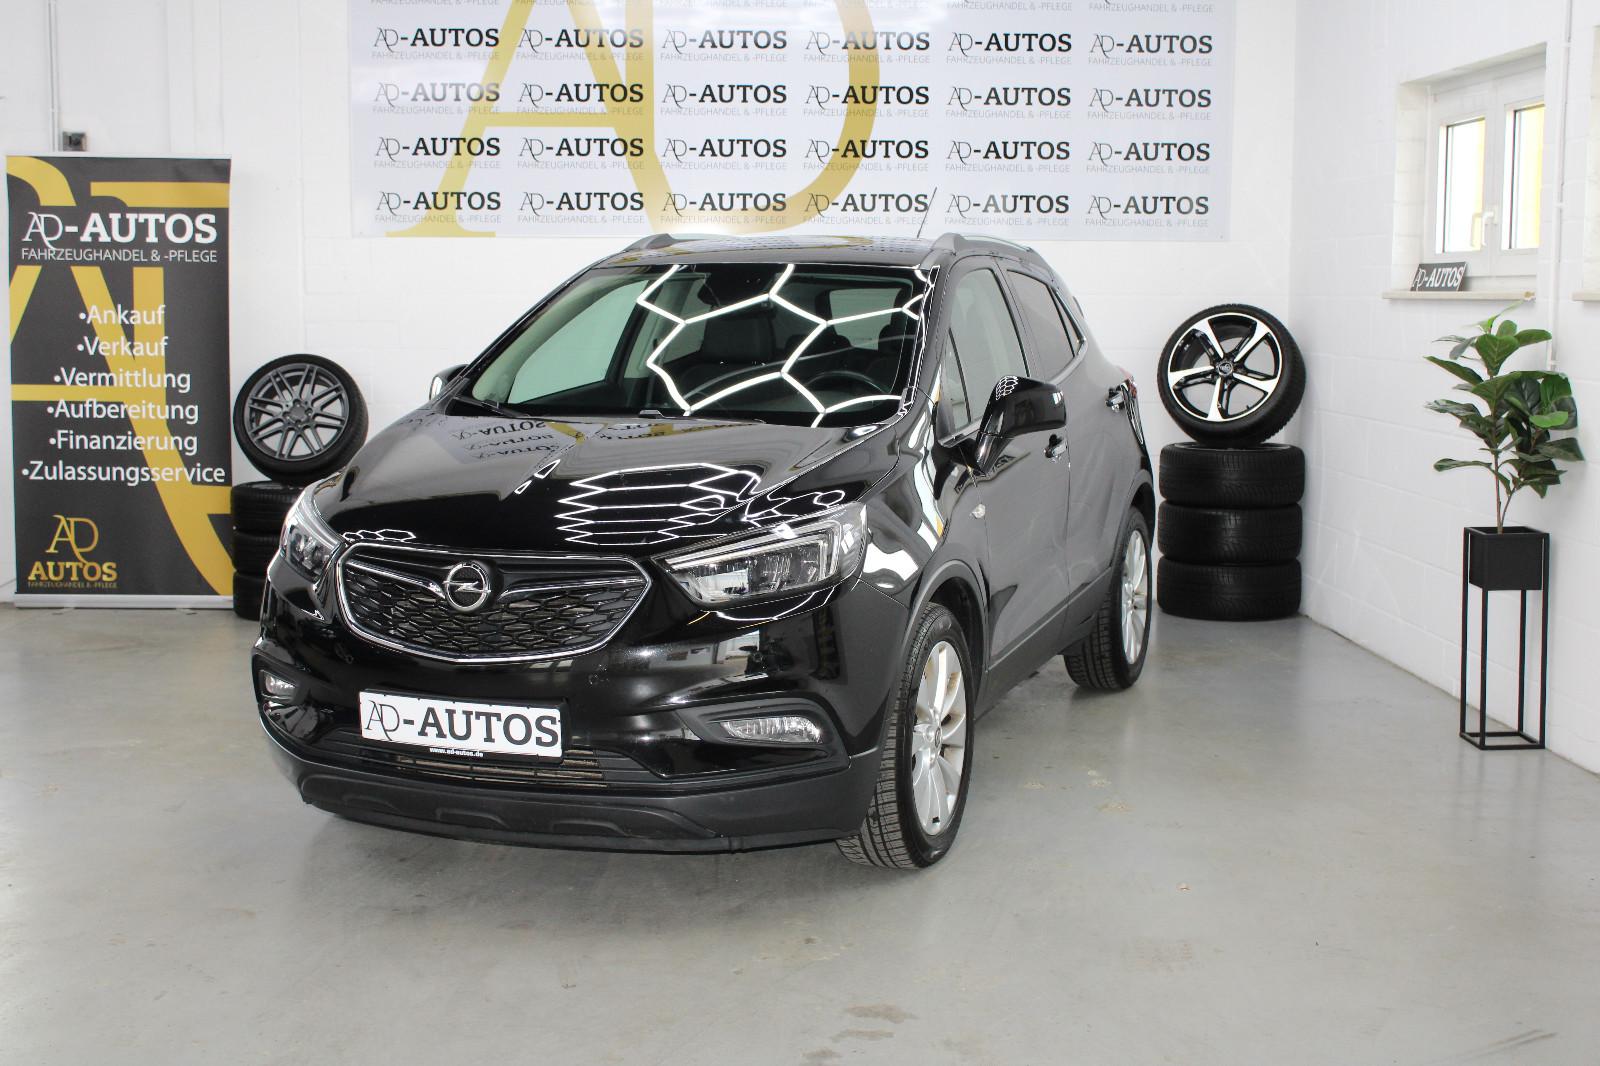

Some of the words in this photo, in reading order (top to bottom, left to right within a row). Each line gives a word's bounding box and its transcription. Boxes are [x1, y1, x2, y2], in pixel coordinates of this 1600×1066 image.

[373, 27, 499, 53] AD-AUTOS
[517, 28, 644, 53] AD-AUTOS
[661, 29, 787, 54] AD-AUTOS
[805, 31, 930, 56] AD-AUTOS
[948, 32, 1072, 56] AD-AUTOS
[1090, 33, 1213, 59] AD-AUTOS
[374, 83, 500, 108] AD-AUTOS
[518, 83, 644, 109] AD-AUTOS
[662, 84, 787, 109] AD-AUTOS
[805, 85, 929, 110] AD-AUTOS
[948, 86, 1071, 110] AD-AUTOS
[1089, 88, 1211, 112] AD-AUTOS
[375, 137, 500, 161] AD-AUTOS
[519, 138, 644, 162] AD-AUTOS
[662, 139, 787, 162] AD-AUTOS
[805, 139, 929, 164] AD-AUTOS
[947, 141, 1070, 165] AD-AUTOS
[1088, 142, 1210, 165] AD-AUTOS
[376, 192, 501, 216] AD-AUTOS
[520, 192, 644, 216] AD-AUTOS
[663, 193, 787, 217] AD-AUTOS
[805, 193, 928, 217] AD-AUTOS
[946, 194, 1069, 218] AD-AUTOS
[1087, 196, 1209, 220] AD-AUTOS
[22, 212, 217, 249] AD-AUTOS
[21, 248, 147, 261] FAHRZEUGHANDEL
[151, 250, 160, 261] &
[164, 250, 217, 263] -PFLEGE
[86, 304, 166, 325] Ankauf
[83, 336, 168, 356] Verkauf
[60, 366, 191, 393] Vermittlung
[53, 399, 199, 424] Aufbereitung
[57, 430, 198, 456] Finanzierung
[29, 460, 225, 486] Zulassungsservice
[45, 514, 99, 563] AD
[28, 561, 118, 581] AUTOS
[364, 700, 559, 747] AD-AUTOS
